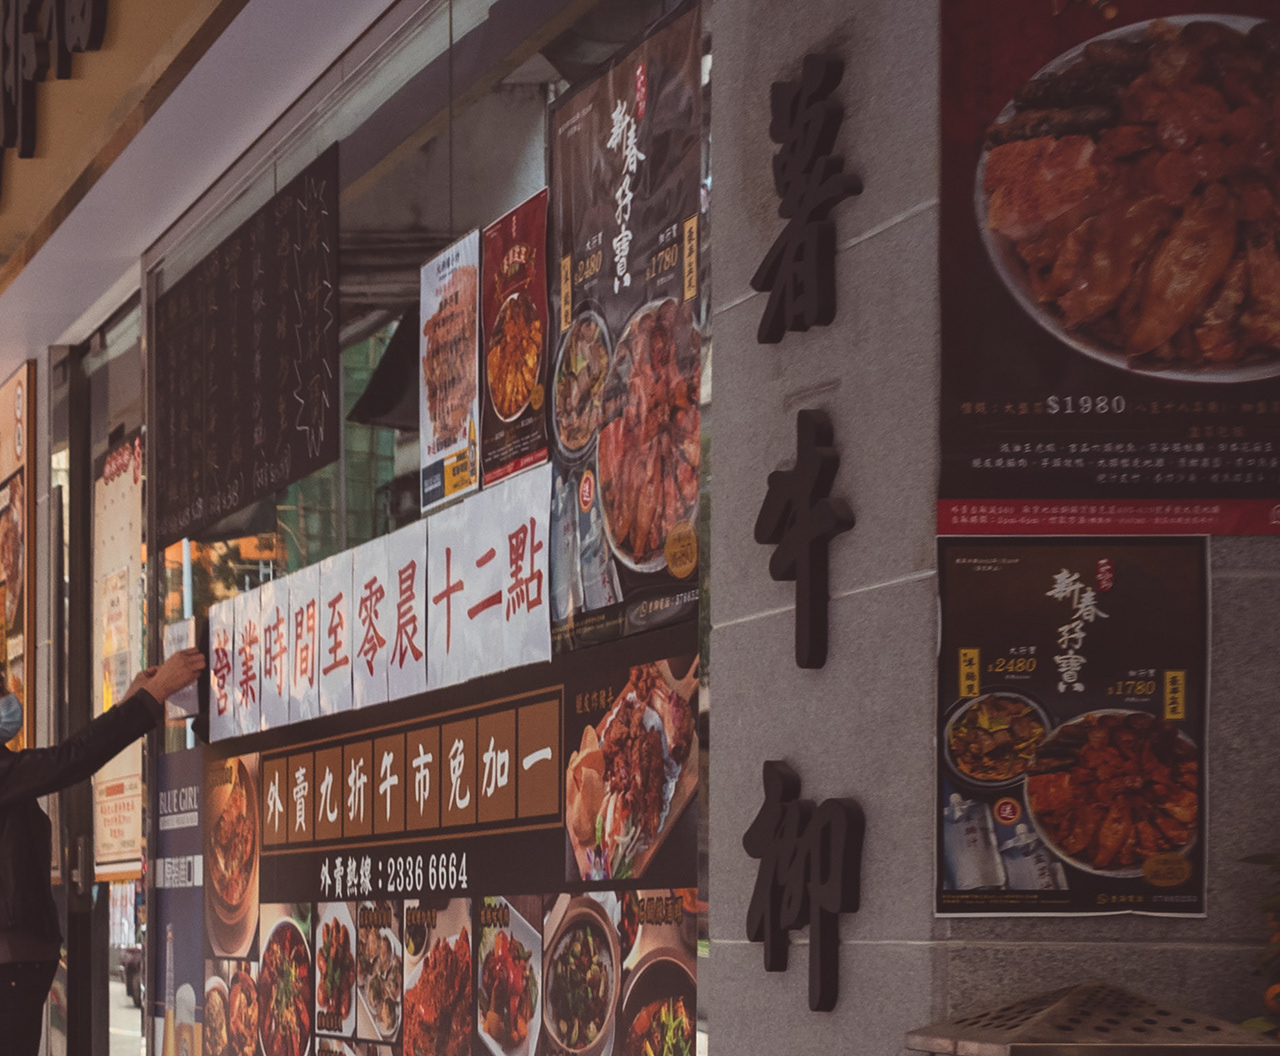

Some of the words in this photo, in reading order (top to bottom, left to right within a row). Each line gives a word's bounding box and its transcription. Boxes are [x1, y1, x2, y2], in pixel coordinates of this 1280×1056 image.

[1046, 395, 1126, 415] $1980
[987, 657, 1038, 673] $2480
[1107, 680, 1157, 696] $1780
[266, 735, 552, 833] 外賣九折午市免加一
[159, 786, 178, 814] BLUE
[180, 785, 199, 811] GIRL
[428, 852, 468, 891] 6664
